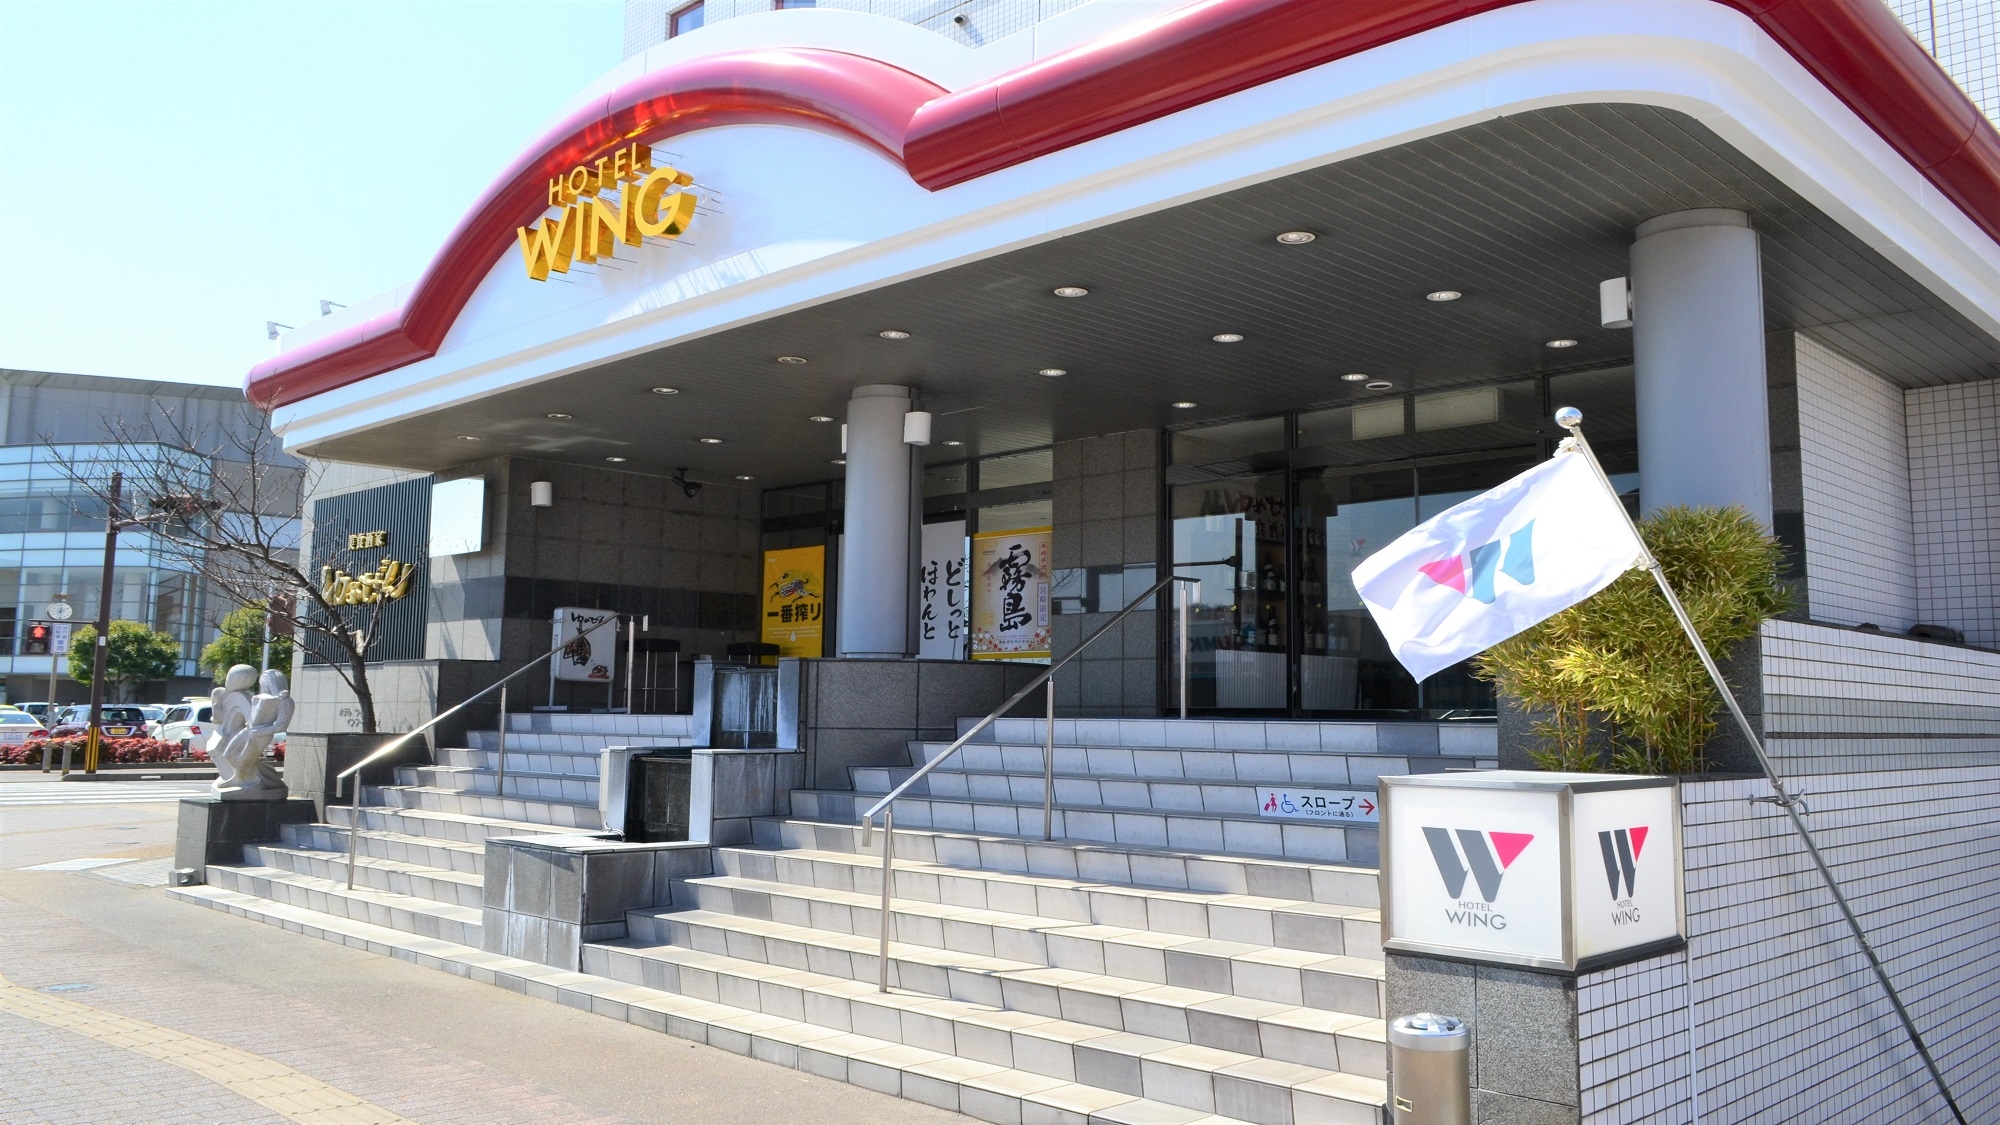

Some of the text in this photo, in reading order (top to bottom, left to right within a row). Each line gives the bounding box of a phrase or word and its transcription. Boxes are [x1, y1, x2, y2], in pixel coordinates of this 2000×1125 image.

[548, 142, 645, 206] HOTEL
[517, 166, 690, 281] WING
[946, 557, 965, 639] どしっと
[999, 543, 1032, 632] 霧島
[921, 560, 939, 640] ほわんと
[767, 603, 821, 623] 一番搾り
[1301, 796, 1356, 810] スロープ
[1458, 900, 1493, 912] HOTEL
[1616, 900, 1633, 908] HOTEL
[1445, 908, 1507, 930] WING
[1611, 907, 1641, 926] WING
